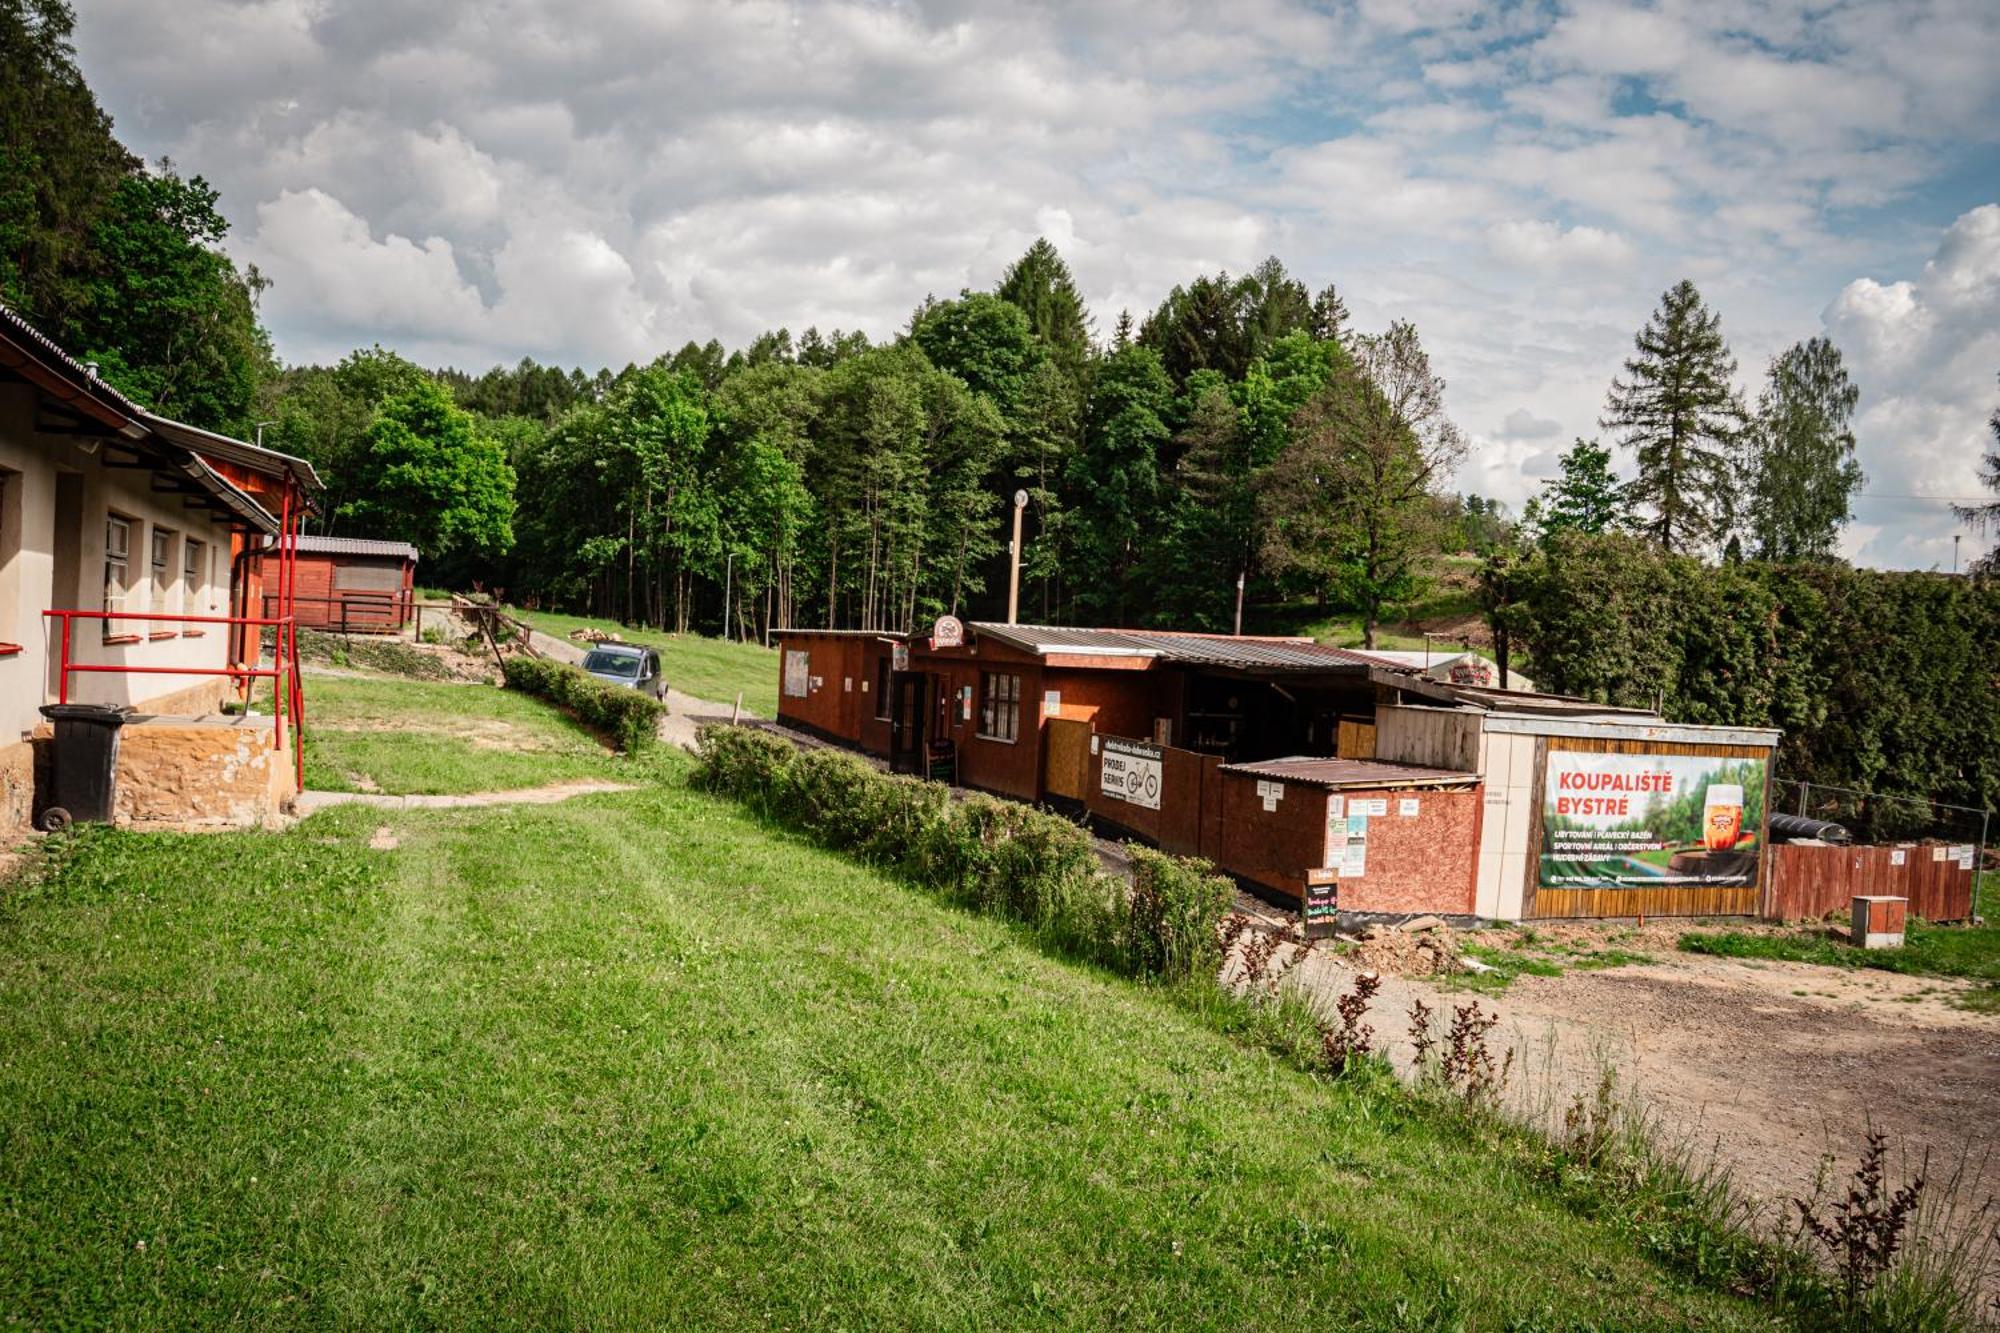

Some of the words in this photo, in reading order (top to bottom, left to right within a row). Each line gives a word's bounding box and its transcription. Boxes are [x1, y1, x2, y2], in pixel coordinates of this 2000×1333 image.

[1104, 758, 1125, 771] PRODEJ
[1104, 773, 1124, 787] SERVIS
[1560, 770, 1672, 792] KOUPALIŠTĚ
[1557, 794, 1628, 815] BYSTRÉ
